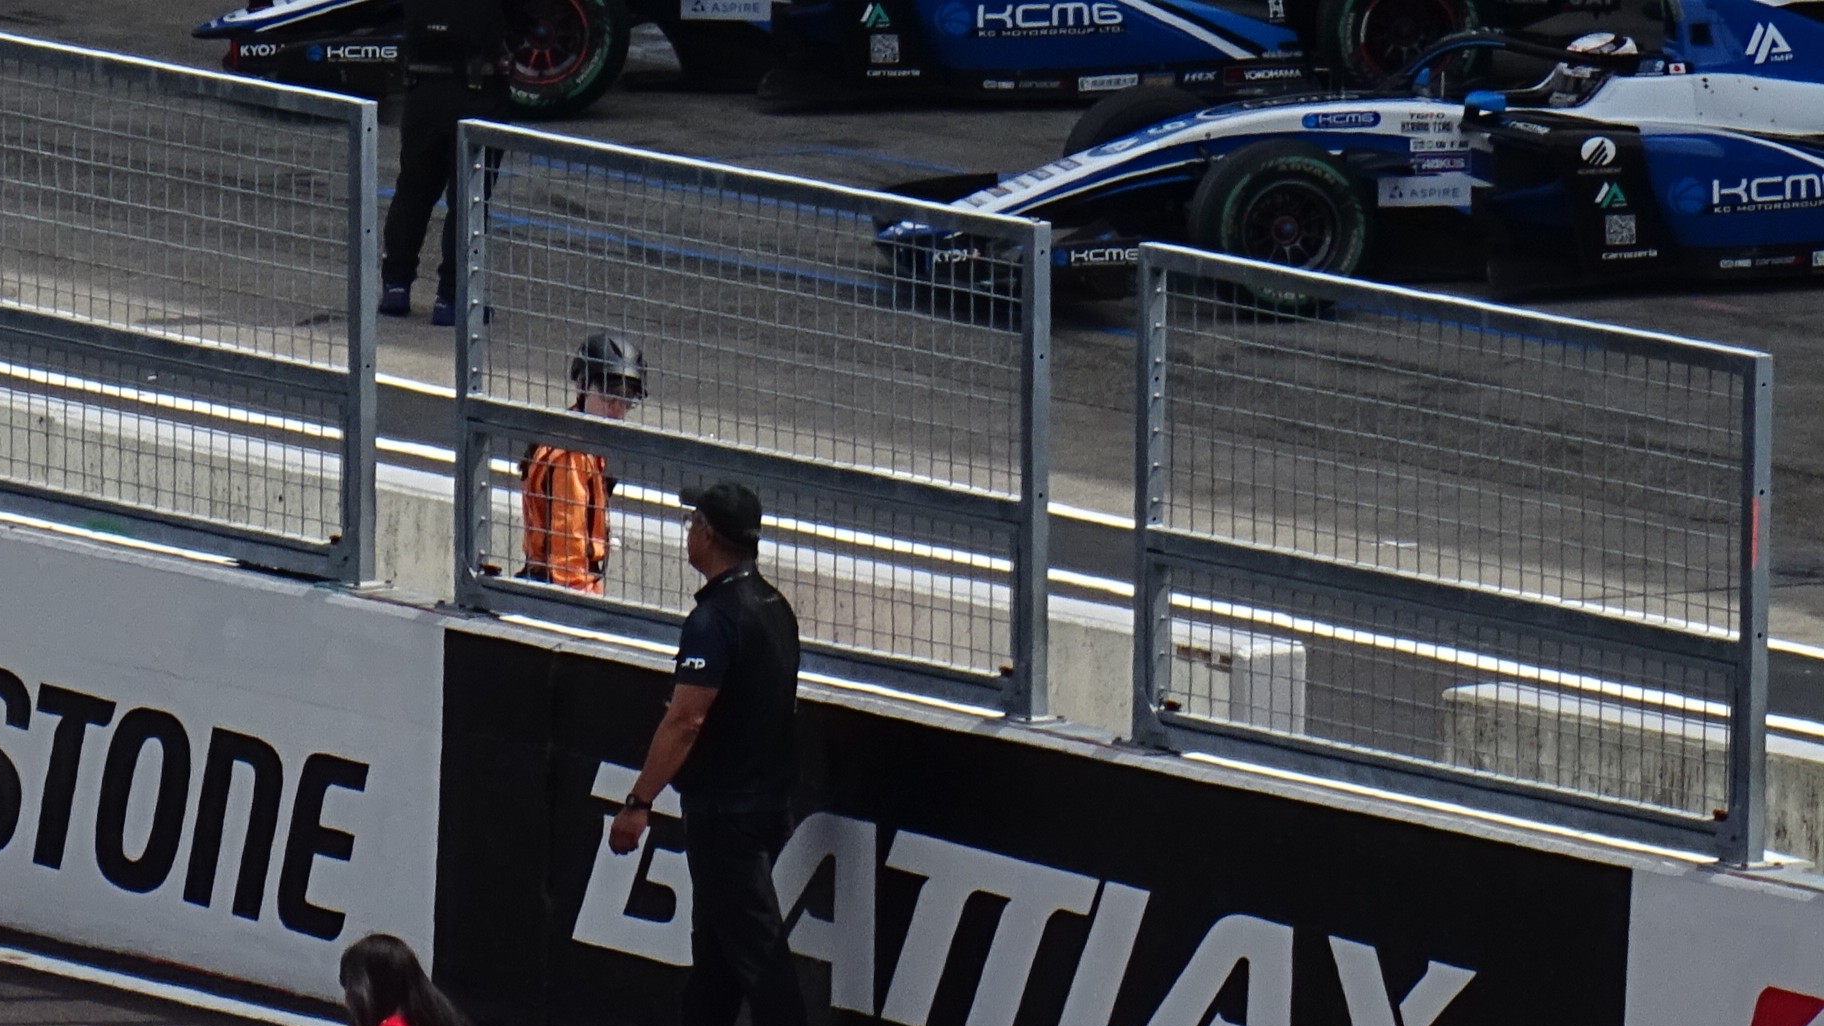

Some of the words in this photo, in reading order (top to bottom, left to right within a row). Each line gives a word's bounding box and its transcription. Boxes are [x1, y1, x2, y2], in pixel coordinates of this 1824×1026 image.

[977, 2, 1123, 28] KCMG
[327, 46, 398, 59] KCMG
[1243, 68, 1302, 81] YOKOHAMA
[1409, 187, 1460, 198] ASPIRE
[1712, 173, 1824, 204] KCM
[1714, 206, 1730, 214] KC
